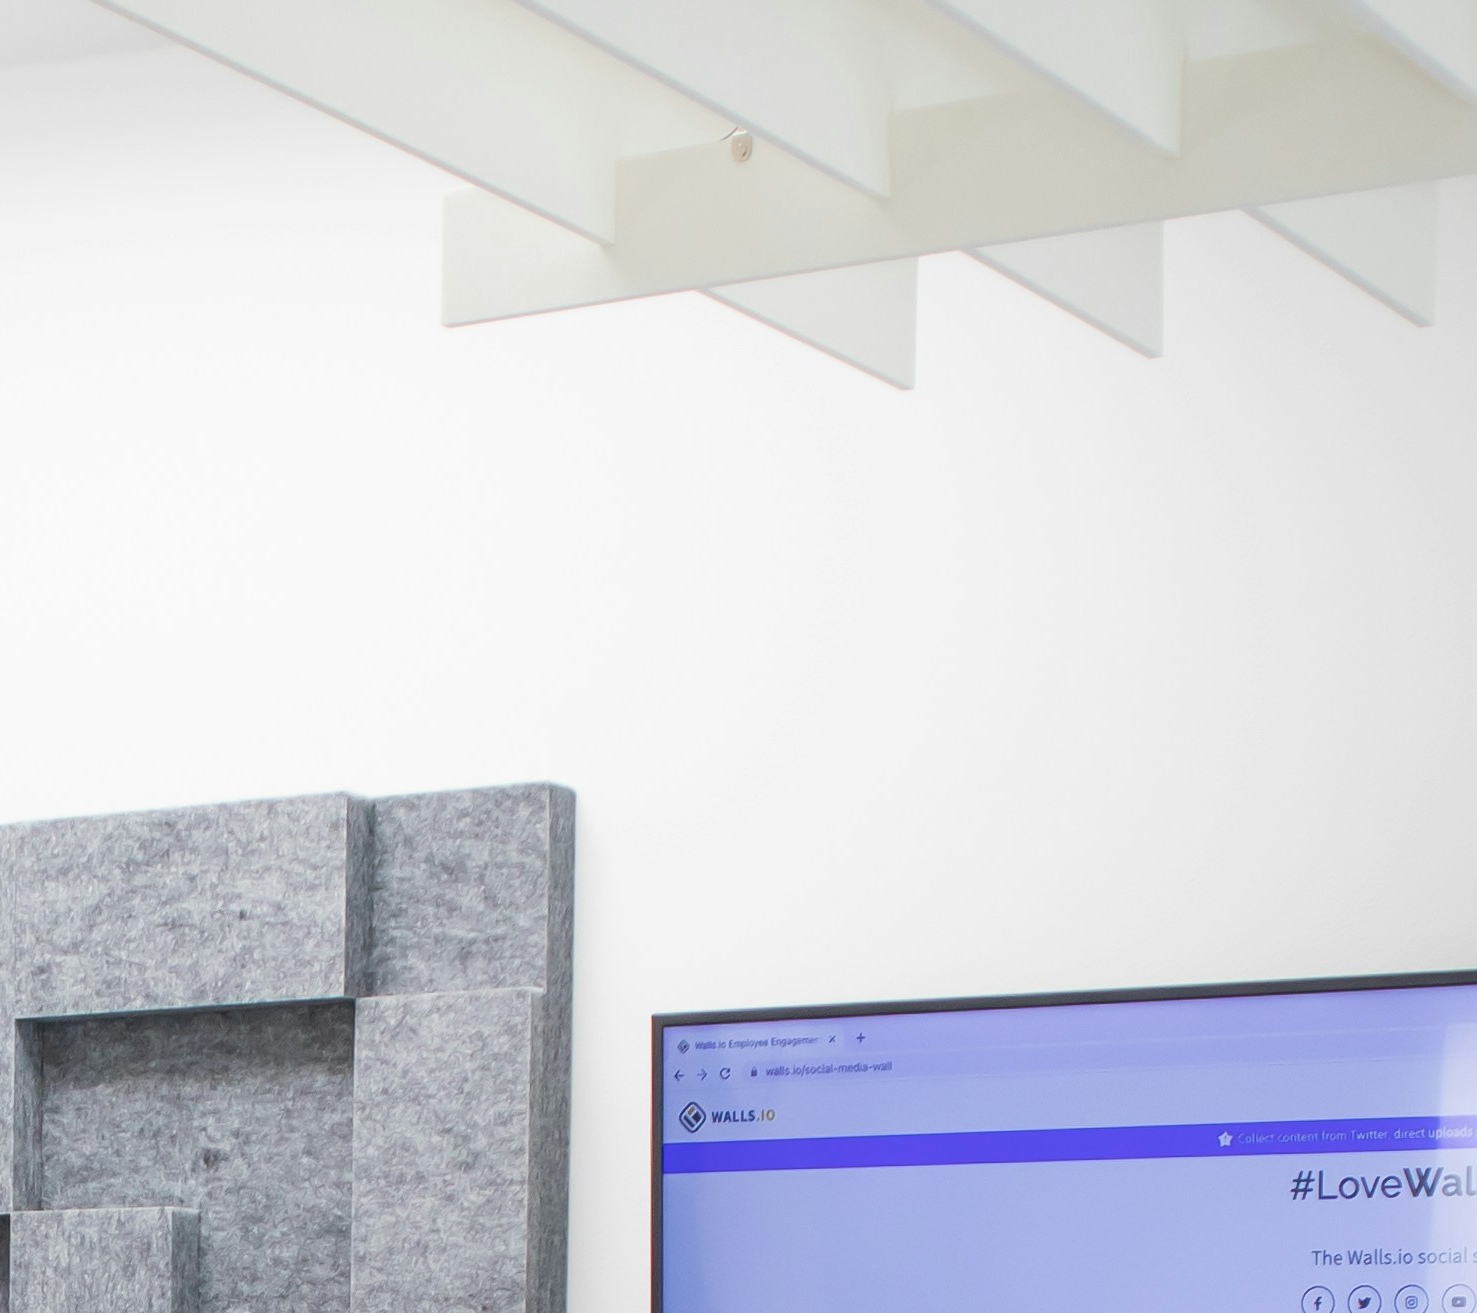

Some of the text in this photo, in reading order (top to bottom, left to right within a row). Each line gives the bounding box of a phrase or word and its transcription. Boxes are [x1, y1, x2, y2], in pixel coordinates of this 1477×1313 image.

[765, 1060, 893, 1078] walls.io/social-media-wall
[710, 1108, 776, 1124] WALLS.IO
[1277, 1130, 1318, 1144] content
[1321, 1129, 1346, 1142] from
[1392, 1127, 1426, 1140] direct
[1428, 1125, 1474, 1141] uploads
[1311, 1249, 1344, 1267] The
[1347, 1248, 1413, 1267] Walls.io
[1417, 1247, 1468, 1266] social
